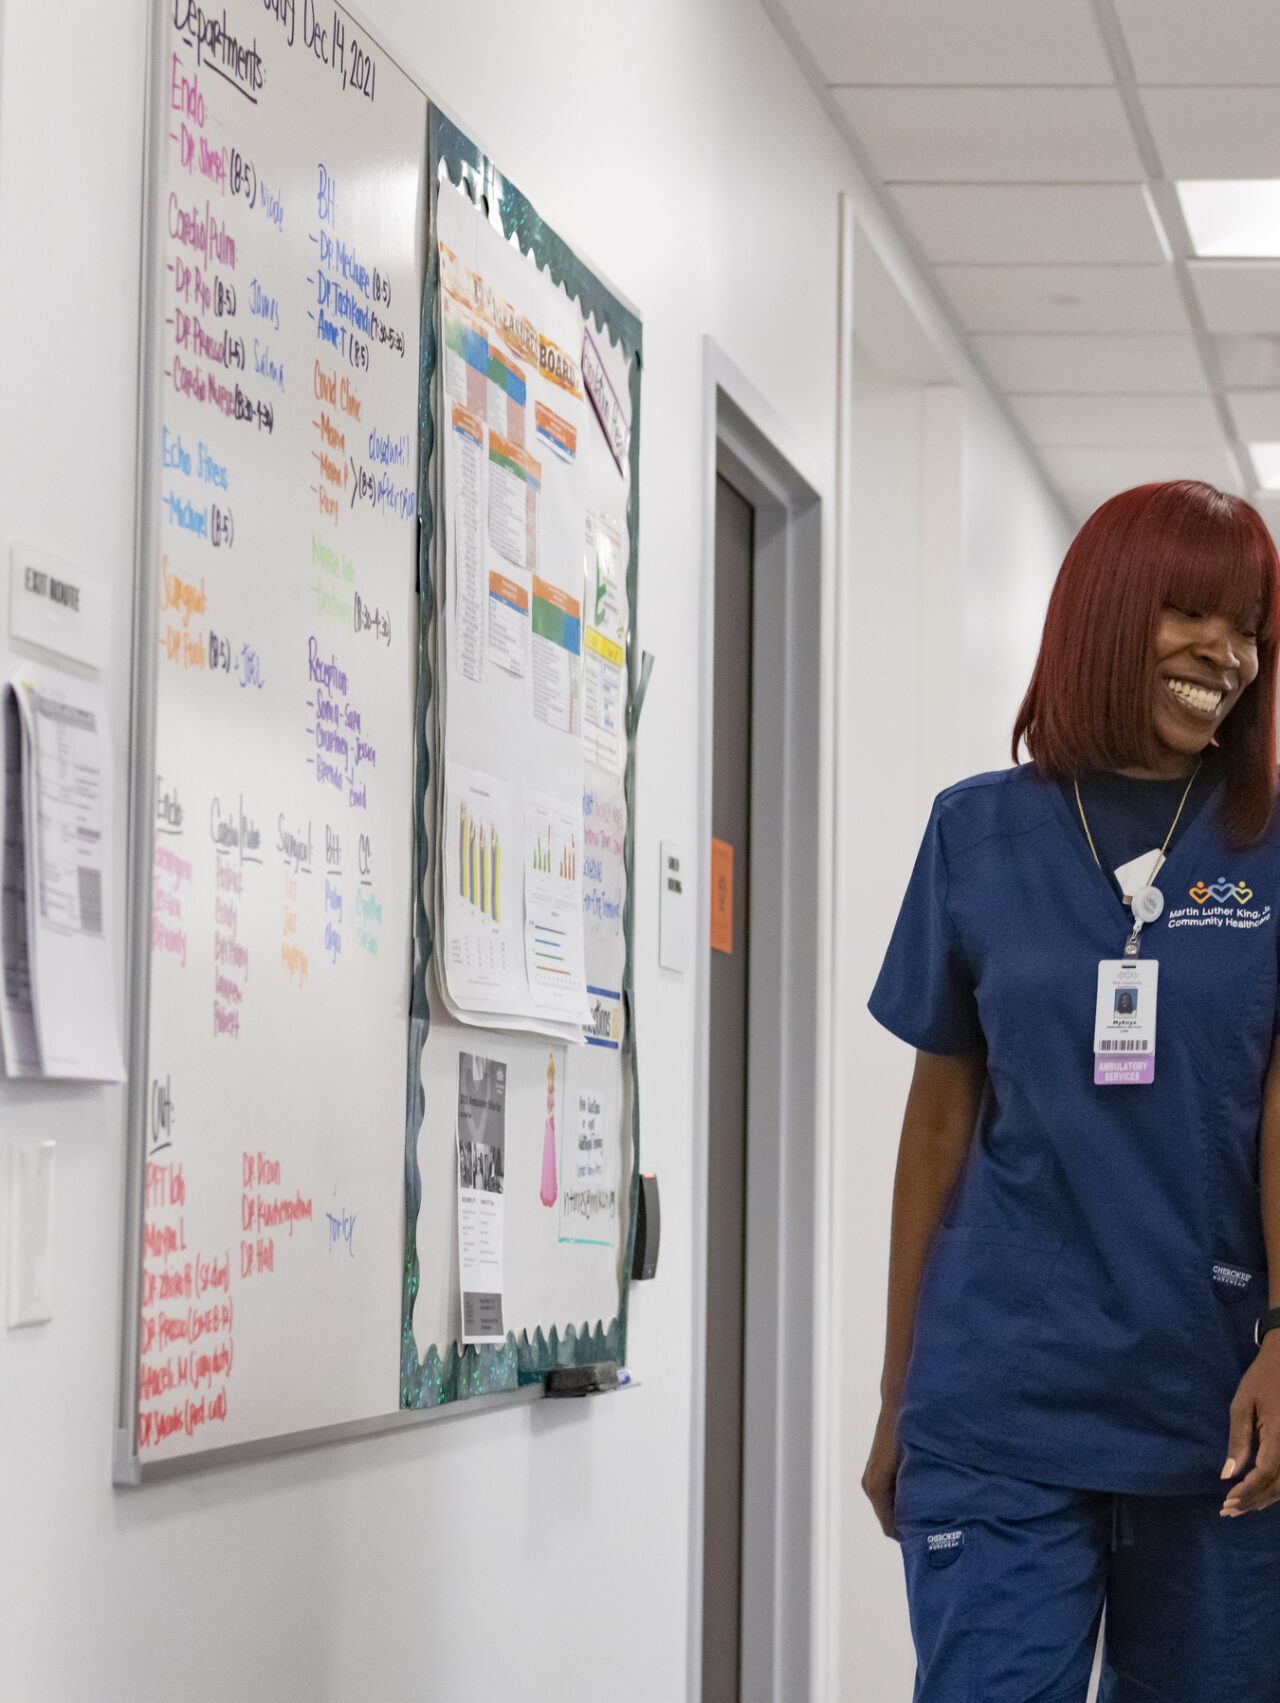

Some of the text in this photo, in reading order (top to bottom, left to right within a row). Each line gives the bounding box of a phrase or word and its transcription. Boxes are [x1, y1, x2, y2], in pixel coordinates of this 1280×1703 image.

[350, 40, 375, 102] 2021
[1169, 907, 1200, 919] Martin
[1202, 907, 1233, 916] Luther
[1168, 916, 1223, 929] Community
[1098, 1061, 1149, 1072] AMBULATORY
[1104, 1072, 1141, 1082] SERVICES
